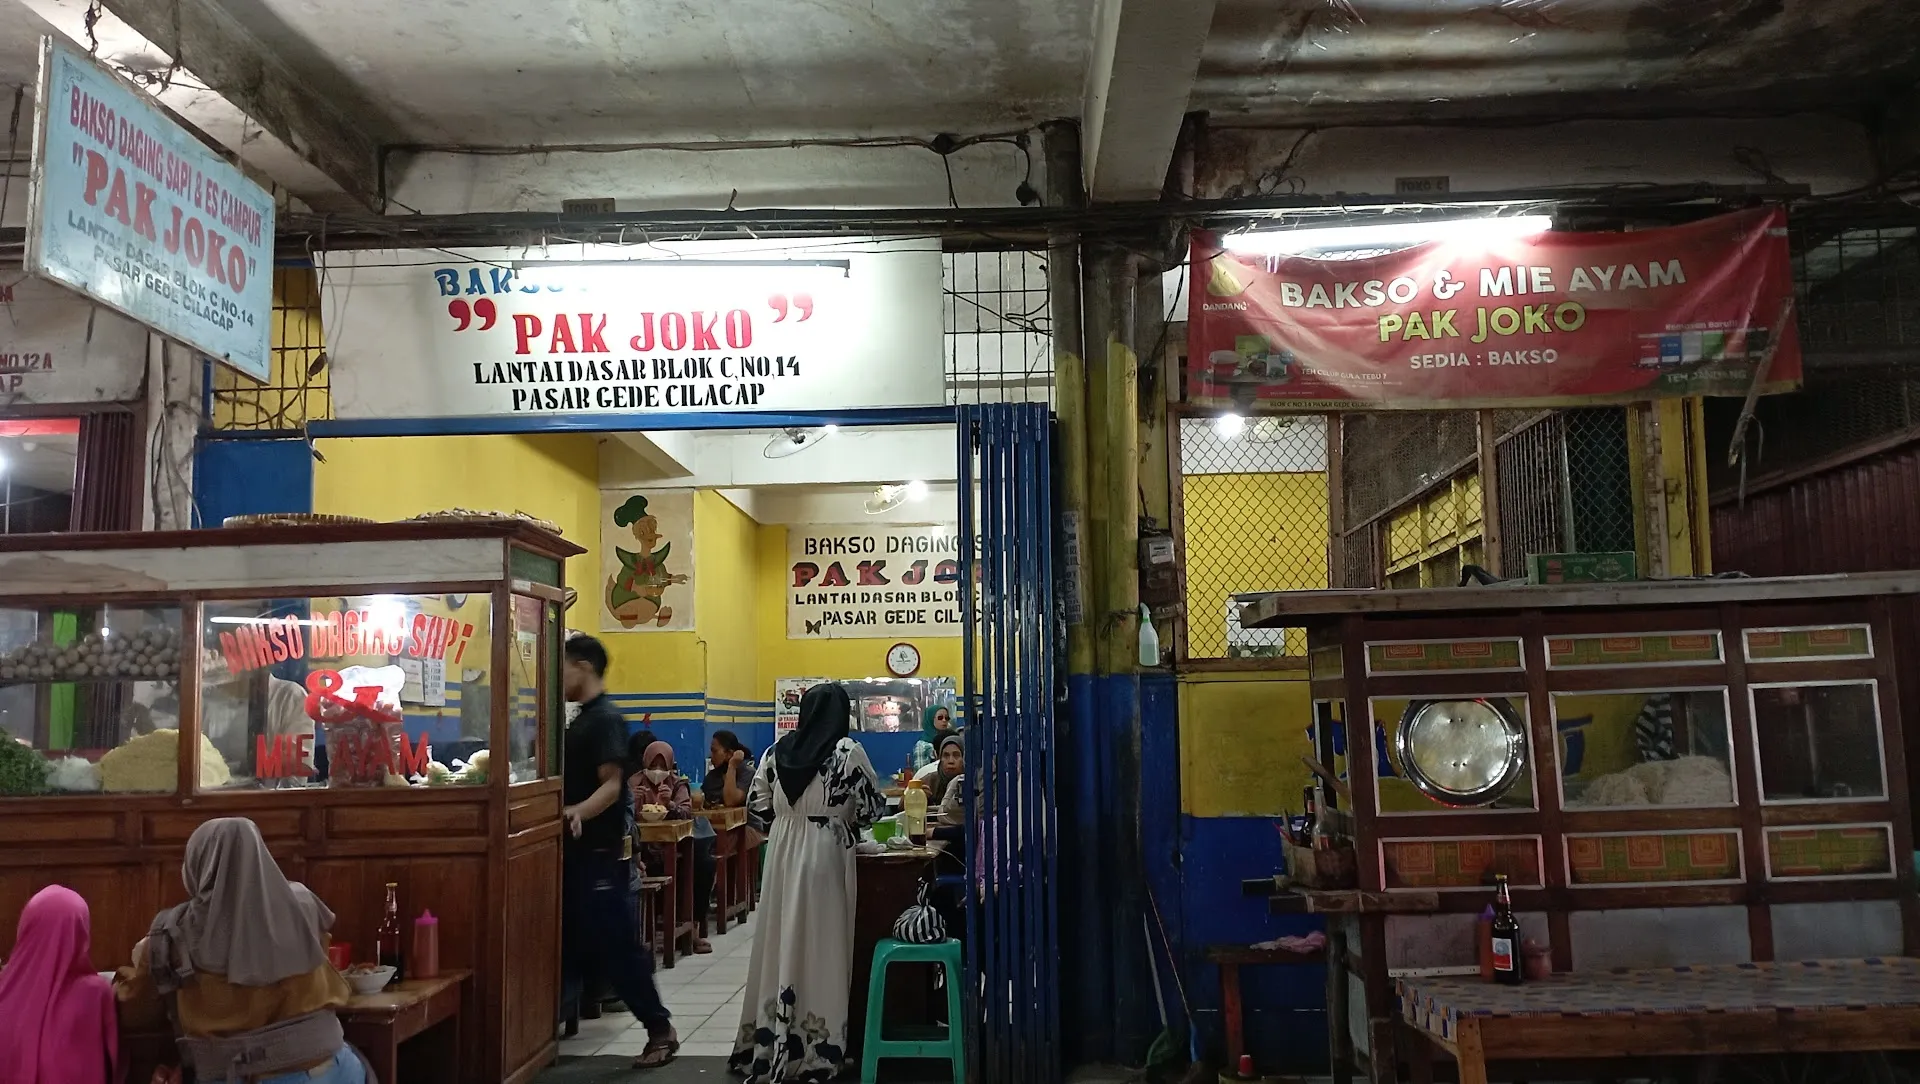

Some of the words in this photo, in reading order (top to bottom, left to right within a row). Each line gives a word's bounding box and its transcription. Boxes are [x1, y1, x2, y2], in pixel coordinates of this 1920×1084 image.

[70, 84, 116, 150] BAKSO
[118, 115, 164, 183] DAGING
[165, 151, 192, 201] SAPI
[194, 170, 203, 209] &
[205, 178, 219, 219] ES
[220, 189, 262, 248] CAMPUR
[67, 208, 121, 251] LANTAI
[125, 242, 170, 282] DASAR
[174, 269, 206, 302] BLOK
[209, 290, 218, 307] C
[93, 244, 141, 284] PASAR
[183, 298, 234, 332] CILACAP
[1279, 276, 1419, 310] BAKSO
[1432, 269, 1466, 300] &
[1479, 265, 1556, 298] MIE
[1568, 259, 1687, 293] AYAM
[1202, 302, 1248, 312] DANDANG
[512, 312, 611, 355] PAK
[629, 308, 754, 352] JOKO
[1378, 309, 1461, 343] PAK
[1470, 301, 1587, 344] JOKO
[473, 361, 563, 385] LANTAI
[568, 359, 646, 383] DASAR
[652, 357, 714, 380] BLOK
[1409, 352, 1471, 370] SEDIA
[1488, 348, 1559, 367] BAKSO
[512, 387, 590, 411] PASAR
[596, 384, 659, 409] GEDE
[665, 383, 766, 408] CILACAP
[804, 536, 876, 555] BAKSO
[791, 559, 891, 588] PAK
[795, 592, 857, 605] LANTAI
[861, 591, 916, 603] DASAR
[822, 609, 877, 626] PASAR
[884, 609, 926, 625] GEDE
[256, 733, 315, 778] MIE
[329, 731, 431, 778] AYAM
